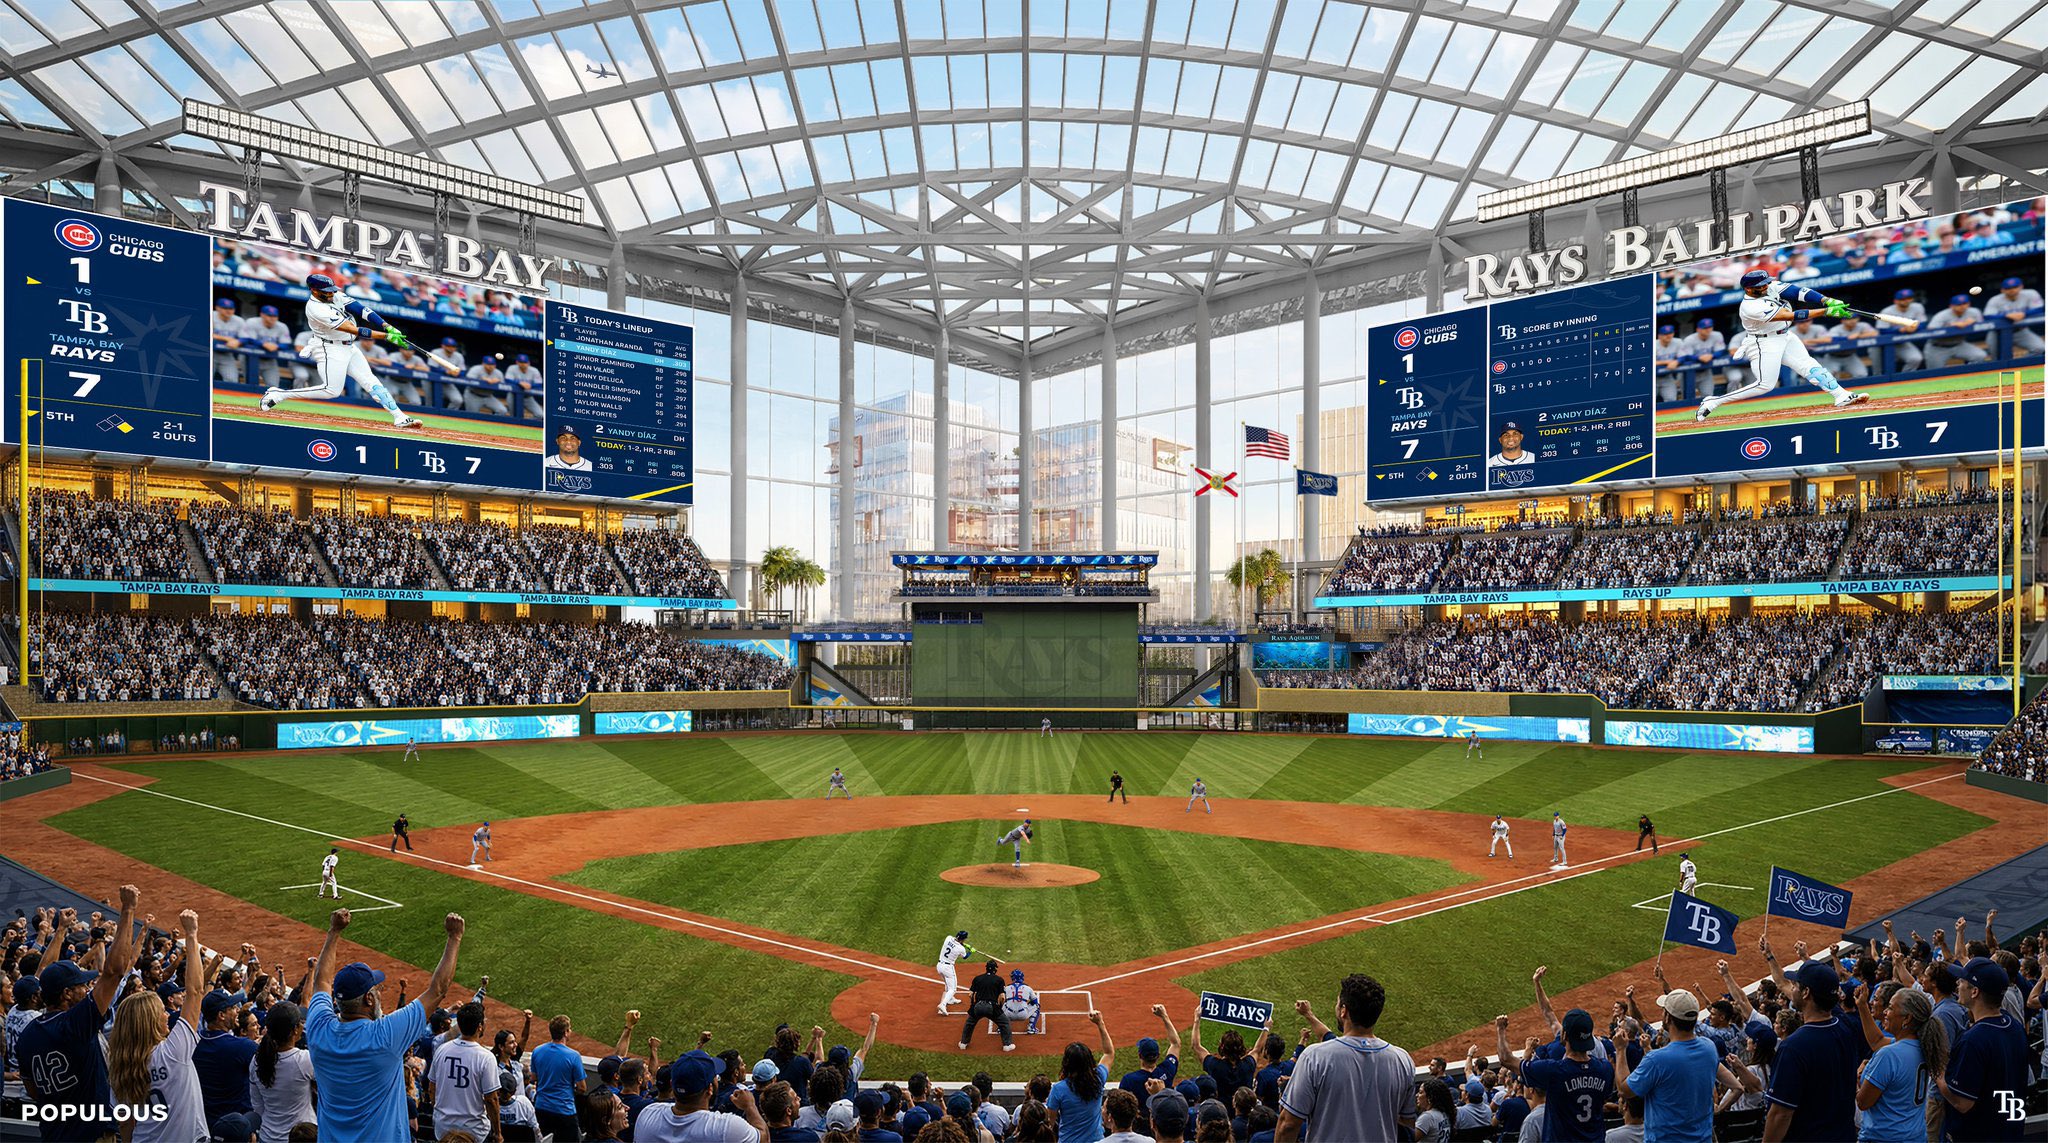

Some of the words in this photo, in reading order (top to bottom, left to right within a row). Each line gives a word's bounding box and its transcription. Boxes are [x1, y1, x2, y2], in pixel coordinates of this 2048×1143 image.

[109, 233, 164, 250] CHICAGO
[200, 181, 432, 271] TAMPA
[442, 232, 554, 293] BAY
[1463, 242, 1587, 302] RAYS
[1607, 176, 1930, 275] BALLPARK
[109, 243, 165, 263] CUBS
[70, 257, 90, 284] 1
[75, 286, 92, 296] VS
[58, 298, 109, 334] TB
[558, 306, 578, 323] TB
[584, 315, 620, 329] TODAY'S
[623, 323, 653, 334] LINEUP
[1423, 323, 1458, 335] CHICAGO
[1498, 324, 1517, 341] TB
[1523, 322, 1551, 334] SCORE
[1553, 320, 1565, 329] BY
[1566, 314, 1598, 326] INNING
[49, 333, 95, 347] TAMPA
[100, 339, 124, 350] BAY
[1423, 331, 1458, 345] CUBS
[50, 344, 116, 363] RAYS
[1402, 353, 1414, 374] 1
[68, 371, 101, 398] 7
[1395, 387, 1424, 410] TB
[46, 411, 74, 422] 5TH
[1390, 413, 1416, 422] TAMPA
[1418, 411, 1433, 419] BAY
[1538, 412, 1547, 422] 2
[1551, 410, 1583, 421] YANDY
[1584, 407, 1607, 418] DÍAZ
[1628, 402, 1642, 410] DH
[163, 421, 183, 431] 2-1
[595, 424, 604, 434] 2
[607, 427, 636, 438] YANDY
[637, 430, 657, 440] DÍAZ
[673, 435, 685, 443] DH
[1391, 419, 1428, 433] RAYS
[1539, 427, 1571, 437] TODAY:
[1573, 425, 1589, 433] 1-2,
[1591, 423, 1606, 431] HR,
[1615, 420, 1631, 428] RBI
[1925, 422, 1949, 443] 7
[152, 431, 161, 440] 2
[163, 432, 197, 443] OUTS
[1790, 436, 1803, 454] 1
[1864, 426, 1900, 449] TB
[355, 446, 367, 464] 1
[596, 441, 626, 451] TODAY:
[628, 445, 642, 453] 1-2,
[643, 447, 656, 455] HR,
[1400, 439, 1420, 459] 7
[1540, 450, 1557, 458] .303
[1597, 445, 1608, 453] 25
[1623, 442, 1643, 451] .806
[418, 450, 446, 474] TB
[465, 457, 482, 474] 7
[1455, 464, 1469, 472] 2-1
[548, 469, 592, 492] RAYS
[1388, 472, 1404, 480] 5TH
[1456, 471, 1477, 480] OUTS
[1491, 468, 1535, 487] RAYS
[120, 582, 160, 593] TAMPA
[164, 583, 188, 594] BAY
[190, 584, 221, 595] RAYS
[340, 588, 376, 598] TAMPA
[379, 590, 398, 599] BAY
[399, 591, 424, 600] RAYS
[1623, 588, 1651, 599] RAYS
[1653, 588, 1671, 597] UP
[1821, 582, 1867, 593] TAMPA
[1871, 581, 1899, 592] BAY
[1902, 579, 1940, 590] RAYS
[520, 594, 548, 603] TAMPA
[551, 595, 567, 604] BAY
[569, 595, 590, 604] RAYS
[659, 598, 684, 606] TAMPA
[686, 599, 702, 607] BAY
[704, 599, 723, 608] RAYS
[1424, 595, 1458, 604] TAMPA
[1460, 594, 1478, 603] BAY
[1481, 592, 1508, 602] RAYS
[1775, 875, 1844, 916] RAYS
[1686, 902, 1721, 945] TB
[944, 948, 951, 958] 2
[1204, 997, 1219, 1016] TB
[1227, 1003, 1266, 1023] RAYS
[32, 1051, 78, 1095] 42
[445, 1057, 469, 1088] TB
[1565, 1077, 1605, 1092] LONGORIA
[1577, 1095, 1592, 1122] 3
